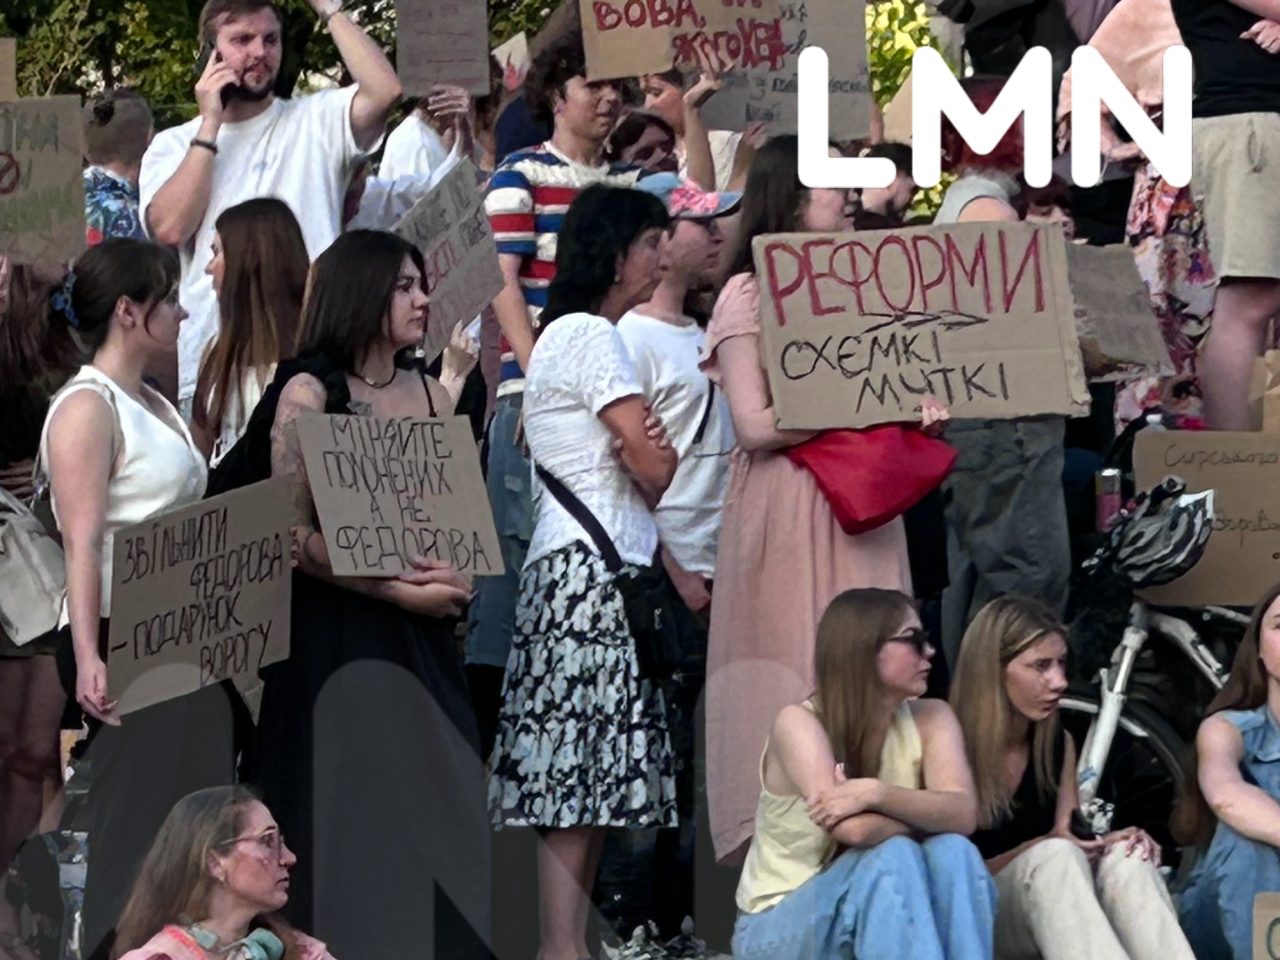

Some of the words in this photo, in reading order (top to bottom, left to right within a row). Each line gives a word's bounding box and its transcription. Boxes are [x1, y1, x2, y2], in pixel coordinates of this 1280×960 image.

[765, 230, 1045, 327] РЕФОРМИ
[370, 495, 384, 522] А
[336, 525, 491, 571] ФЕДОРОВА
